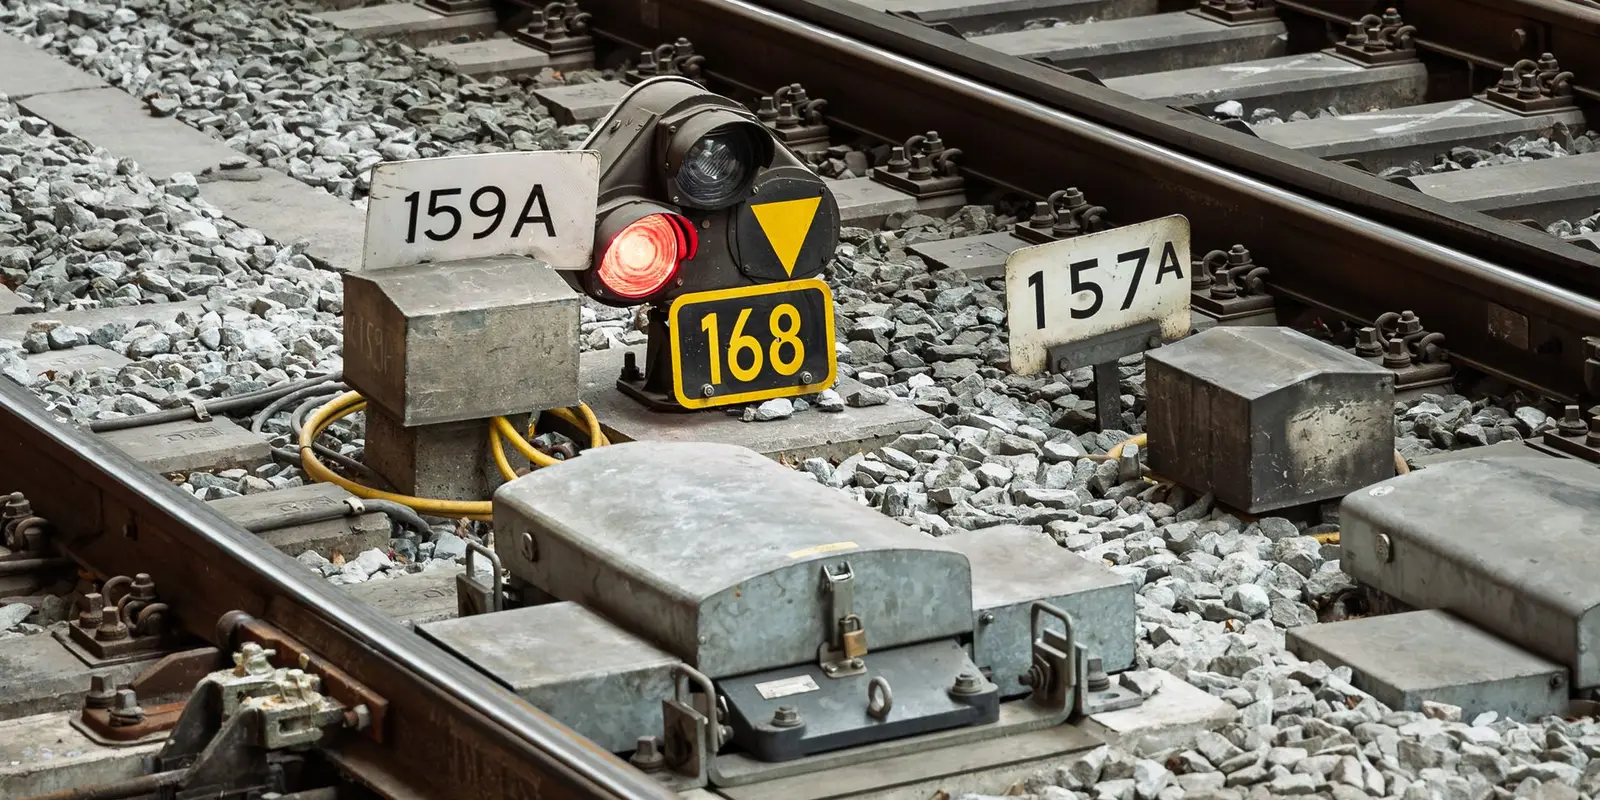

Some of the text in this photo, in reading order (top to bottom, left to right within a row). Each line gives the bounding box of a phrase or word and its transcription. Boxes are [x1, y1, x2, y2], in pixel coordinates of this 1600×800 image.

[404, 184, 557, 243] 159A
[1028, 241, 1184, 330] 157A
[701, 303, 805, 385] 168
